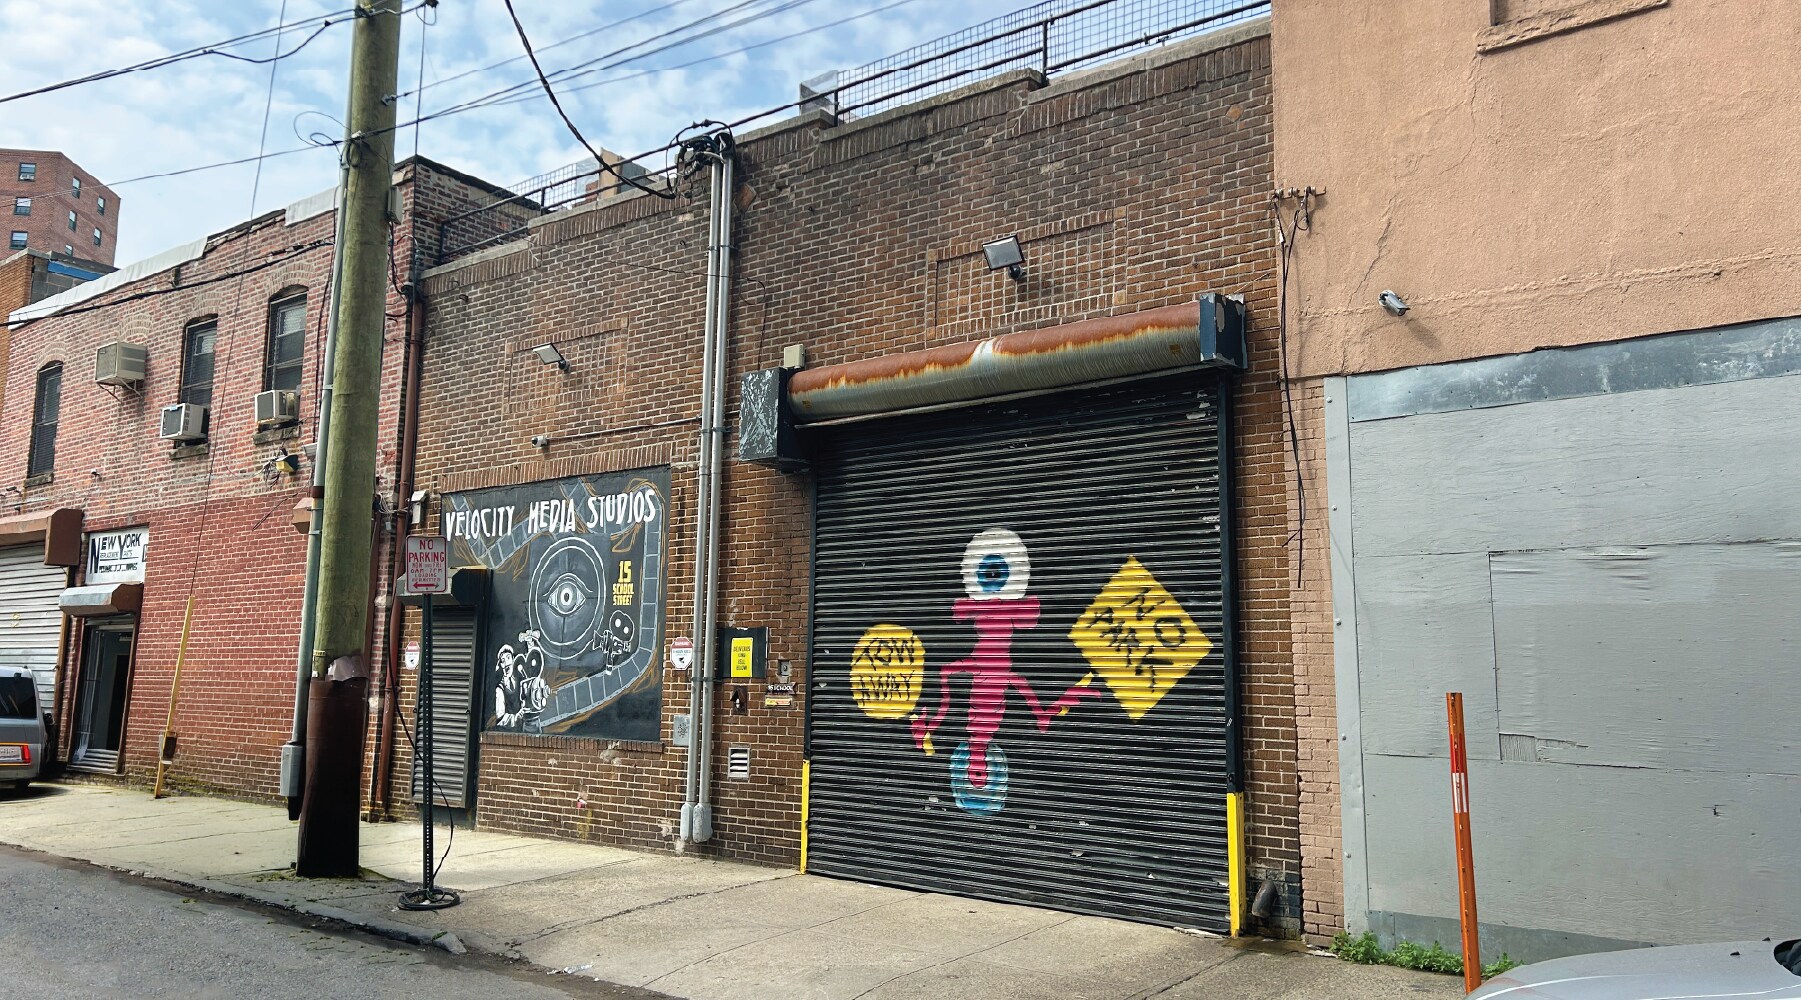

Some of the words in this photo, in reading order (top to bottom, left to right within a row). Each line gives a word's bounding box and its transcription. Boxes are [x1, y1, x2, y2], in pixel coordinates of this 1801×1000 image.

[446, 505, 515, 542] VELOCITY
[528, 499, 576, 534] MEDIA
[587, 489, 656, 529] STUDIOS
[90, 535, 117, 574] NEW
[118, 533, 142, 560] YORK
[408, 552, 445, 562] PARKING
[419, 539, 434, 550] NO
[618, 560, 632, 583] 15
[612, 583, 635, 595] SCHOOL
[612, 595, 633, 606] STREET
[1120, 586, 1188, 651] NO
[853, 637, 916, 672] TOW
[858, 669, 916, 707] AWAY
